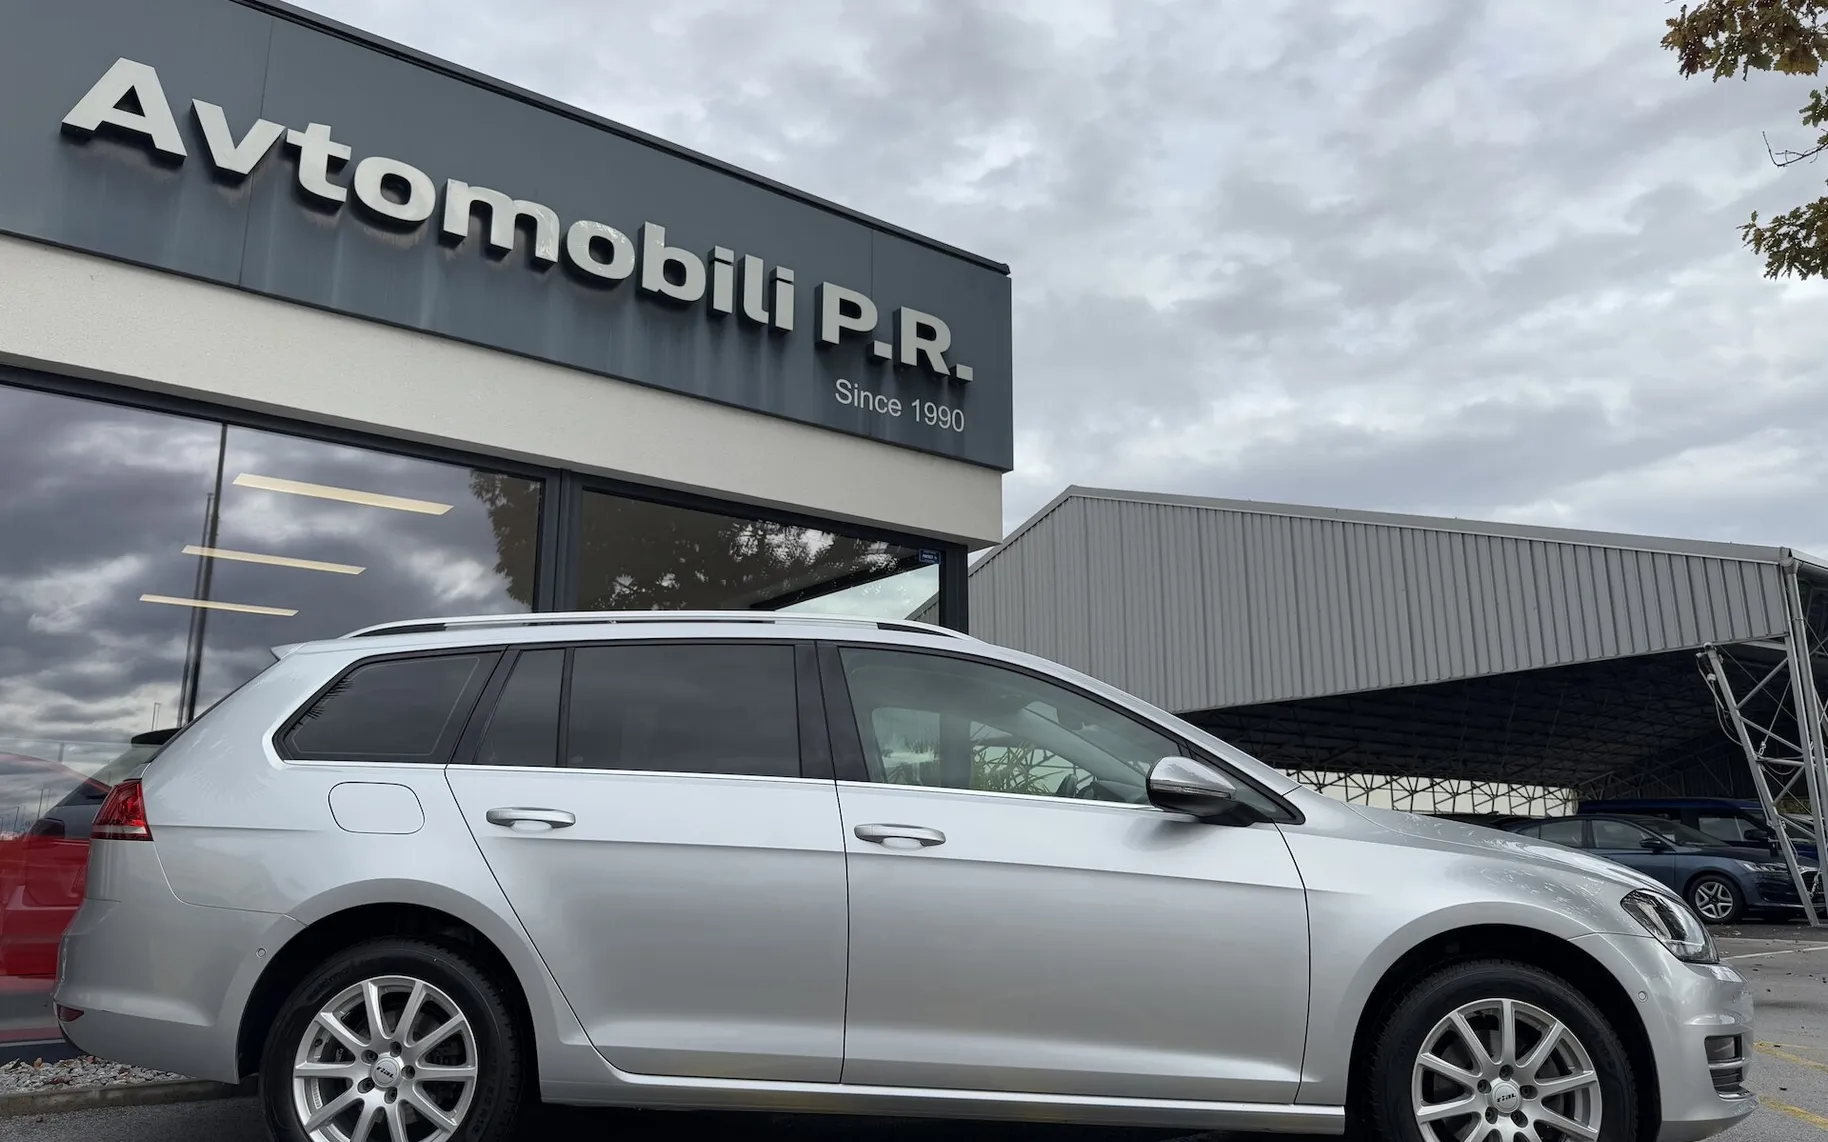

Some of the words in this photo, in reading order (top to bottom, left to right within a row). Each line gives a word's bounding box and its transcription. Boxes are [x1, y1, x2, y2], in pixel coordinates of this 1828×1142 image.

[61, 57, 795, 332] Avtomobili
[818, 281, 974, 383] P.R.
[835, 378, 902, 417] Since
[911, 399, 965, 432] 1990
